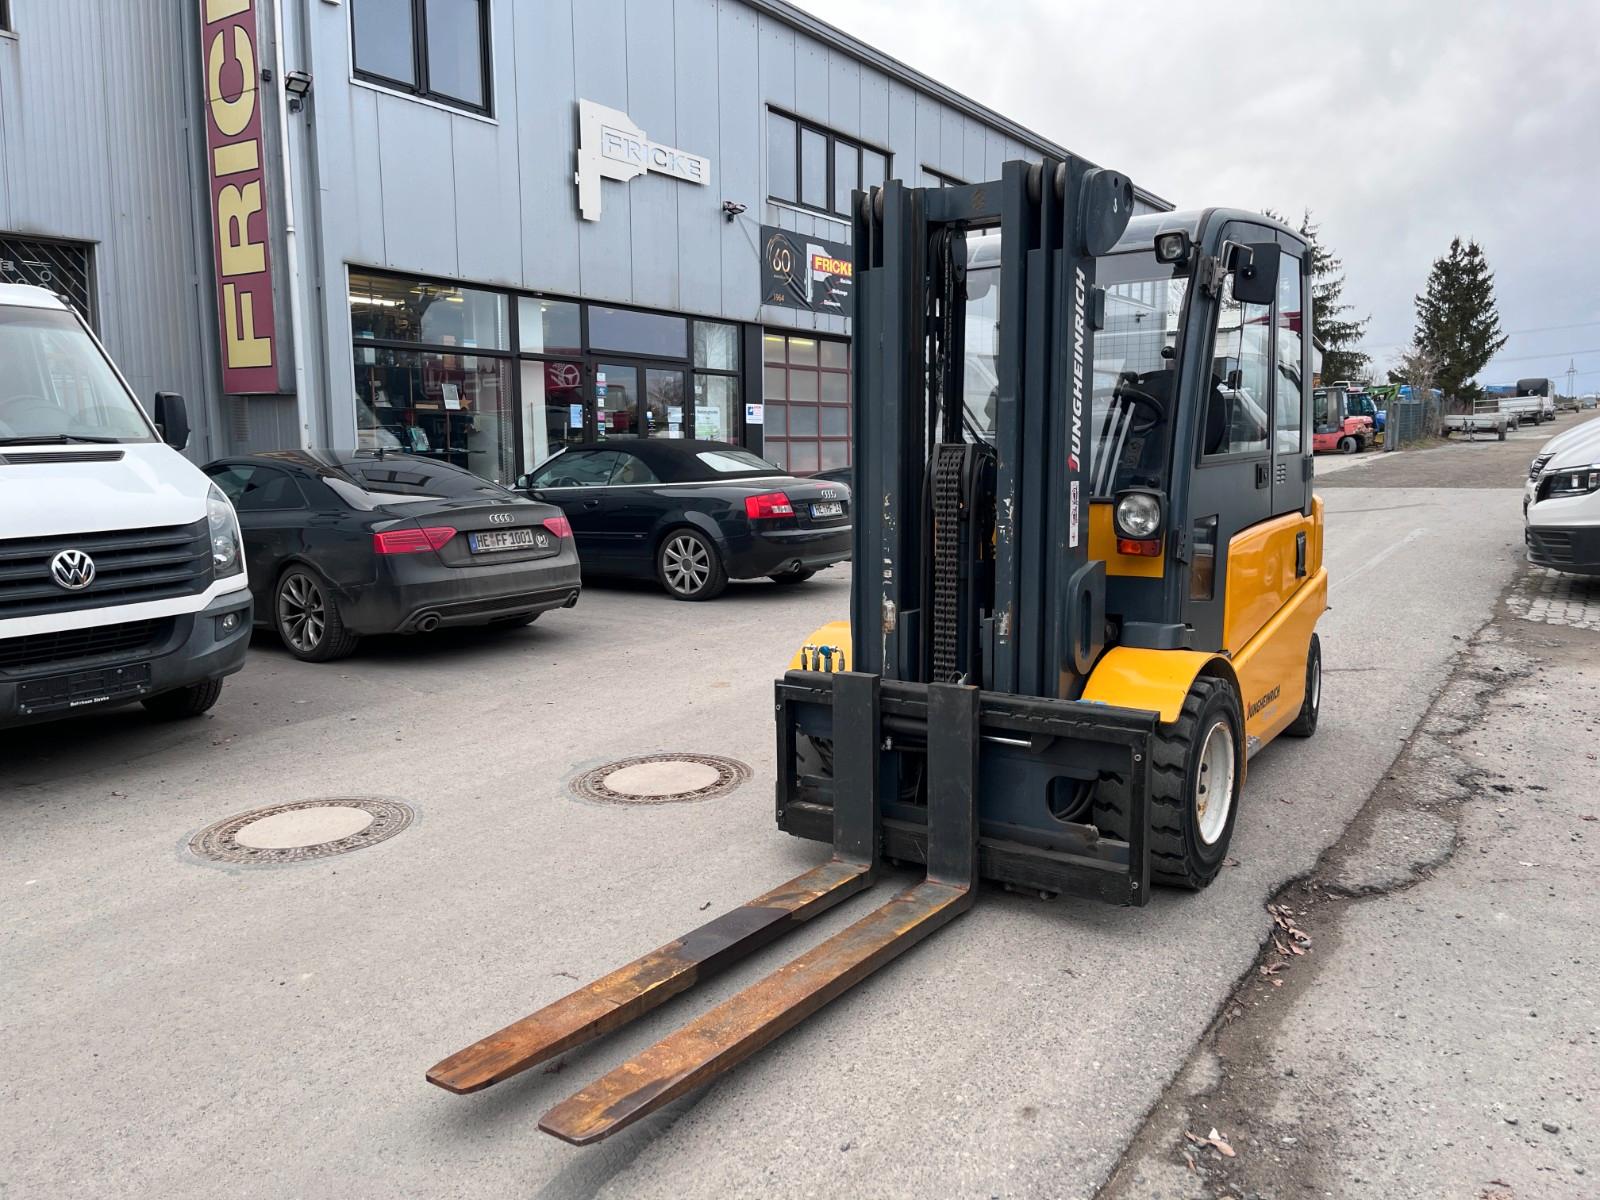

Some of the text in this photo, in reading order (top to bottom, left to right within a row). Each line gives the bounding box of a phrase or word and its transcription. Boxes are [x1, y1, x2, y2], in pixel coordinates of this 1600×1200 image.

[605, 132, 701, 179] FRICKE
[206, 0, 272, 369] FRIC
[773, 247, 791, 273] 60
[1067, 266, 1087, 473] JUNGHEINRICH
[476, 533, 490, 547] HE
[496, 532, 508, 546] FF
[509, 530, 533, 545] 1001
